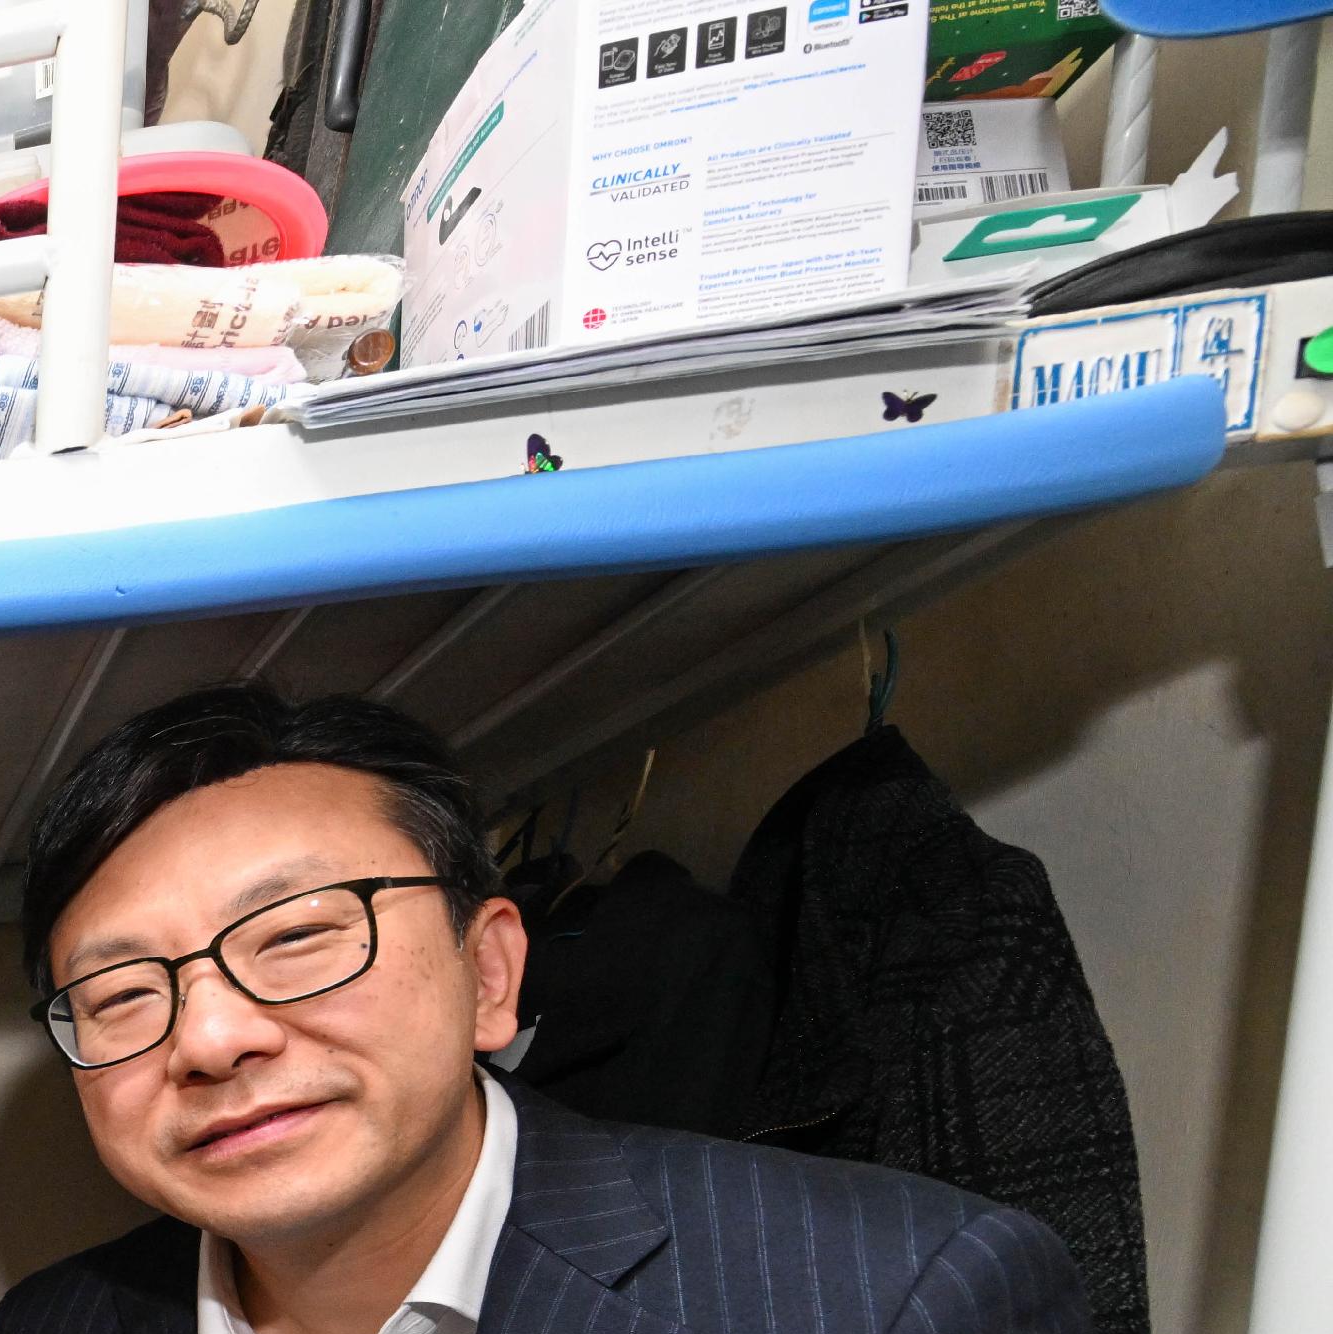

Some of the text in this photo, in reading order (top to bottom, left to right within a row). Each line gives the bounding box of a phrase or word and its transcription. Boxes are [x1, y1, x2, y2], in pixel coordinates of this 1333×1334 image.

[591, 136, 693, 161] WHY CHOOSE OMRON?
[721, 148, 757, 159] Products
[774, 137, 811, 150] Clinically
[814, 130, 852, 143] Validated
[592, 162, 681, 190] CLINICALLY
[610, 179, 690, 203] VALIDATED
[758, 194, 803, 209] Technology
[746, 207, 782, 221] Accuracy
[627, 229, 680, 252] Intelli
[625, 247, 679, 267] sense
[698, 279, 744, 292] Experience
[780, 267, 804, 279] Blood
[805, 262, 842, 276] Pressure
[844, 256, 881, 269] Monitors
[699, 269, 730, 281] Trusted
[732, 266, 756, 276] Brand
